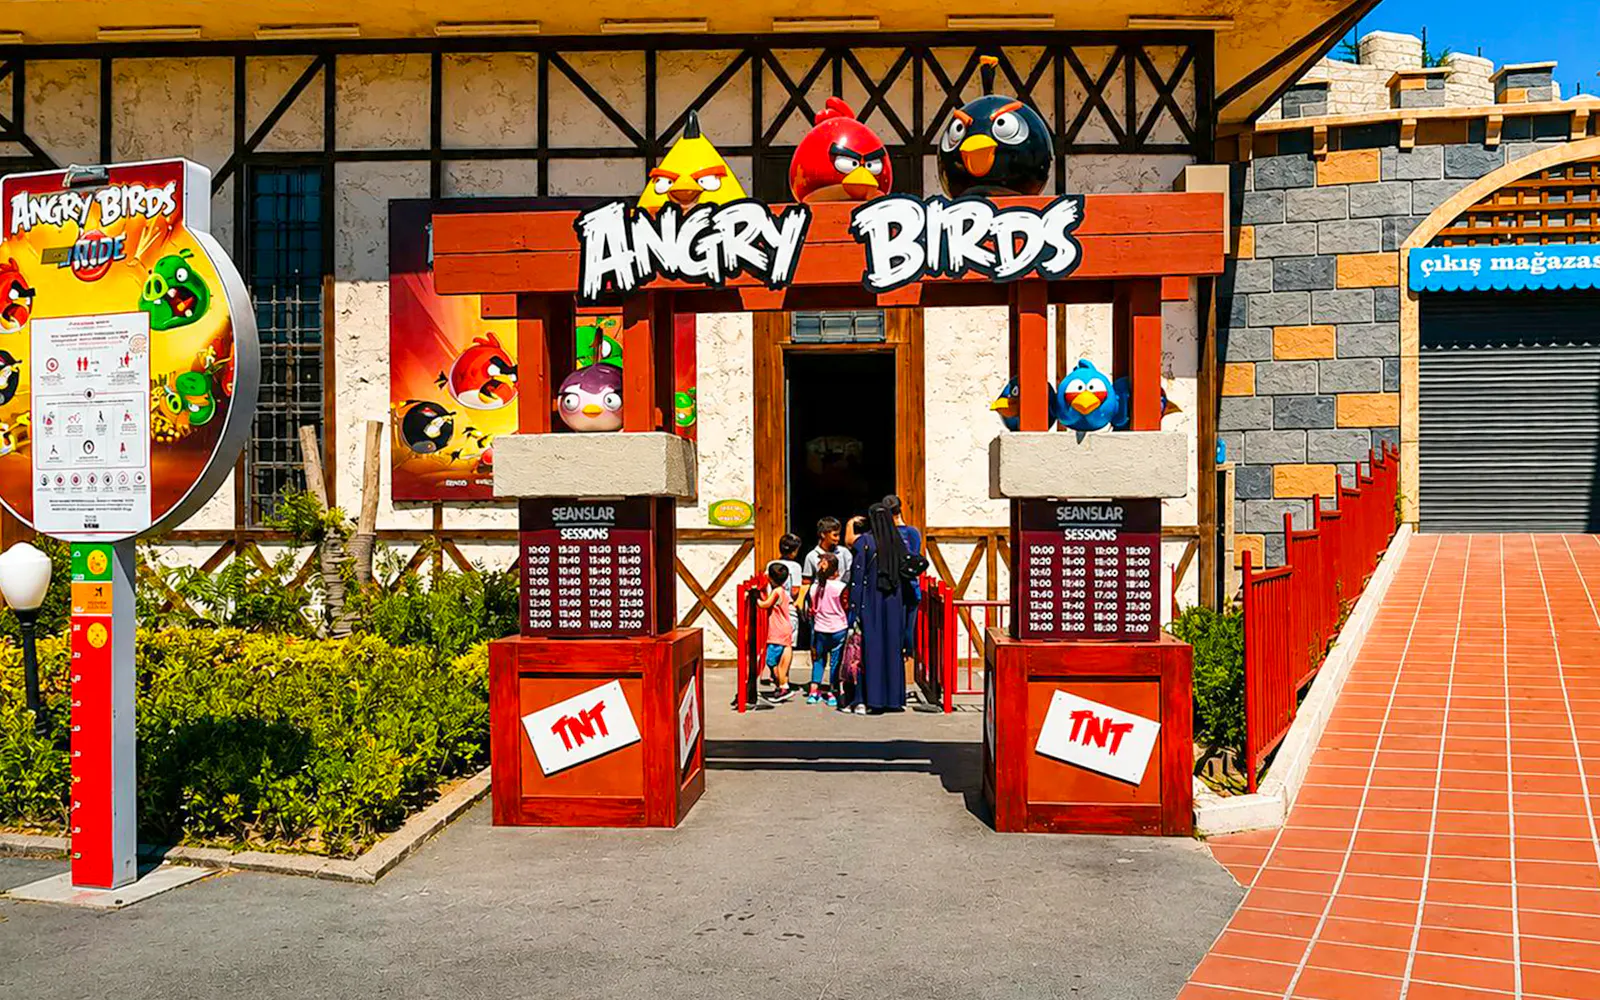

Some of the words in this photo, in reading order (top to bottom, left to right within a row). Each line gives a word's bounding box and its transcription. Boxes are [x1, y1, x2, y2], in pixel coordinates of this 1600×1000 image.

[10, 190, 94, 235] ANGRY
[96, 180, 176, 226] BIRDS
[576, 199, 807, 300] ANGRY
[850, 197, 1080, 288] BIRDS
[1420, 254, 1482, 278] çıkış
[552, 506, 615, 521] SEANSLAR
[1056, 506, 1124, 521] SEANSLAR
[560, 528, 609, 540] SESSIONS
[1064, 529, 1117, 541] SESSIONS
[1030, 545, 1054, 555] 10:00
[550, 700, 609, 752] TNT
[1069, 709, 1134, 756] TNT
